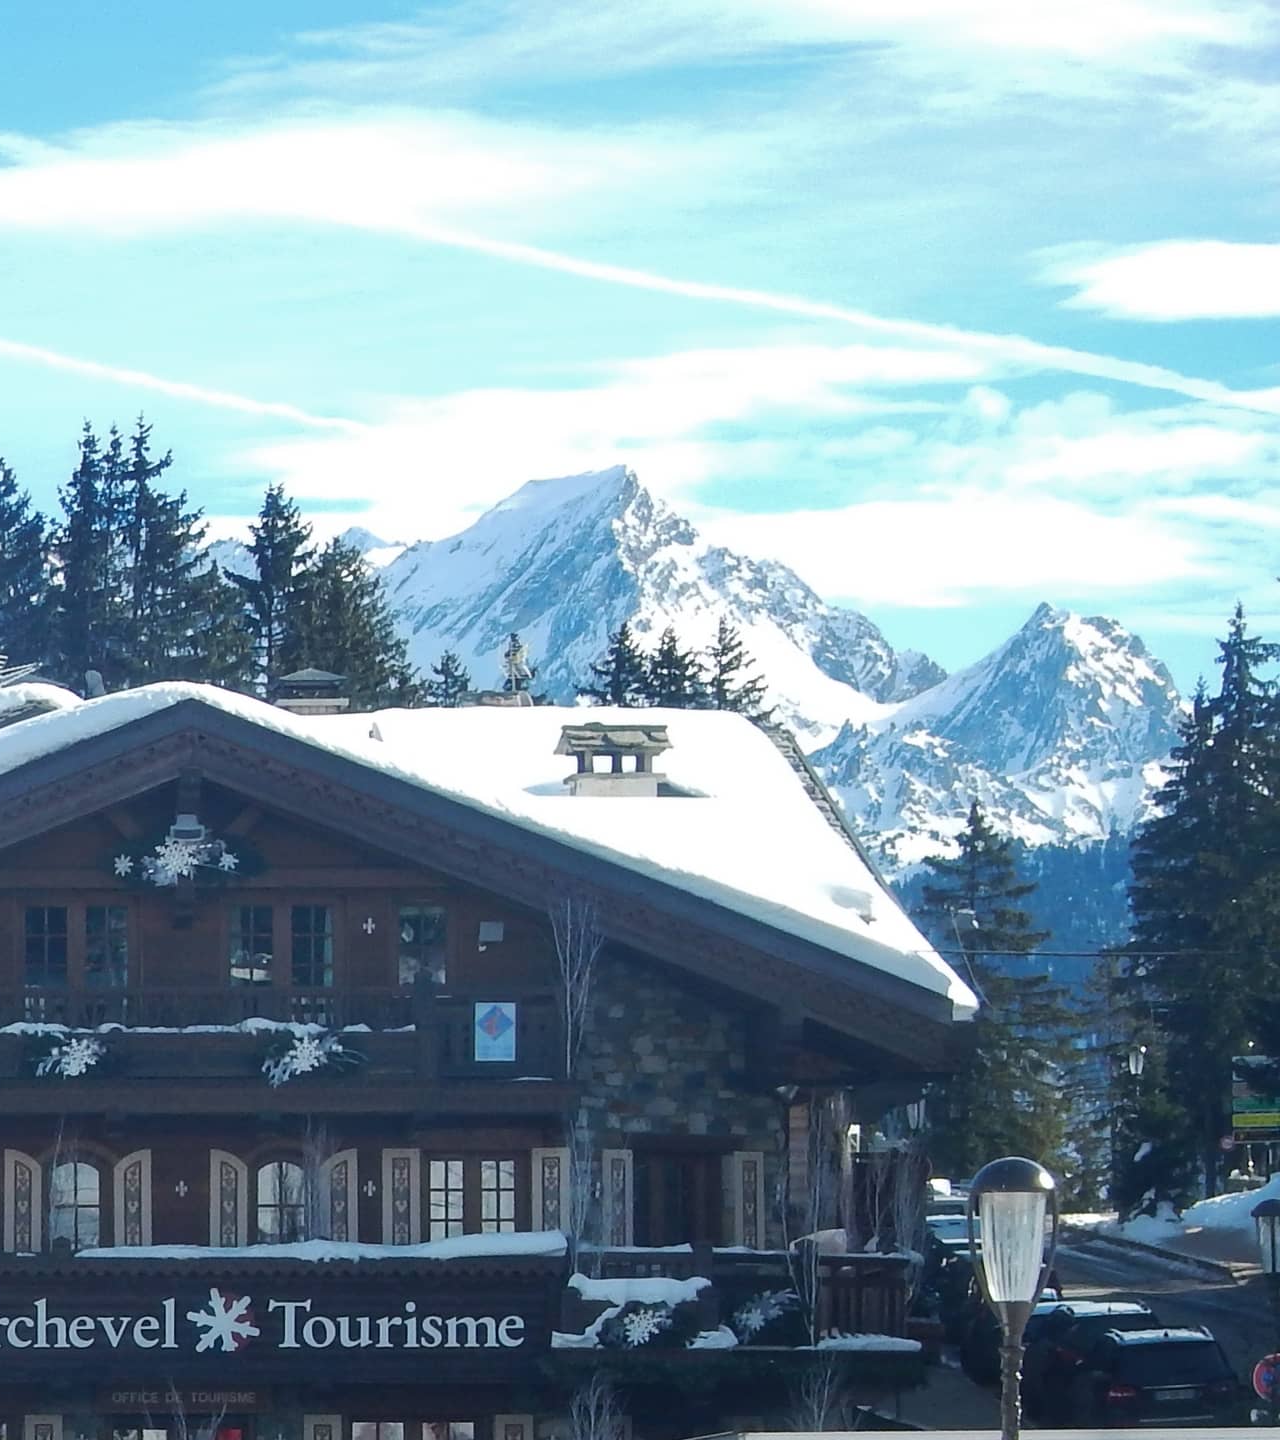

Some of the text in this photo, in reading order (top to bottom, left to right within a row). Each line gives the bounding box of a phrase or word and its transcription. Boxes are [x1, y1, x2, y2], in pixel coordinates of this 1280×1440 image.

[268, 1299, 526, 1349] Tourisme
[112, 1391, 159, 1404] OFFICE
[191, 1391, 256, 1404] TOURISME
